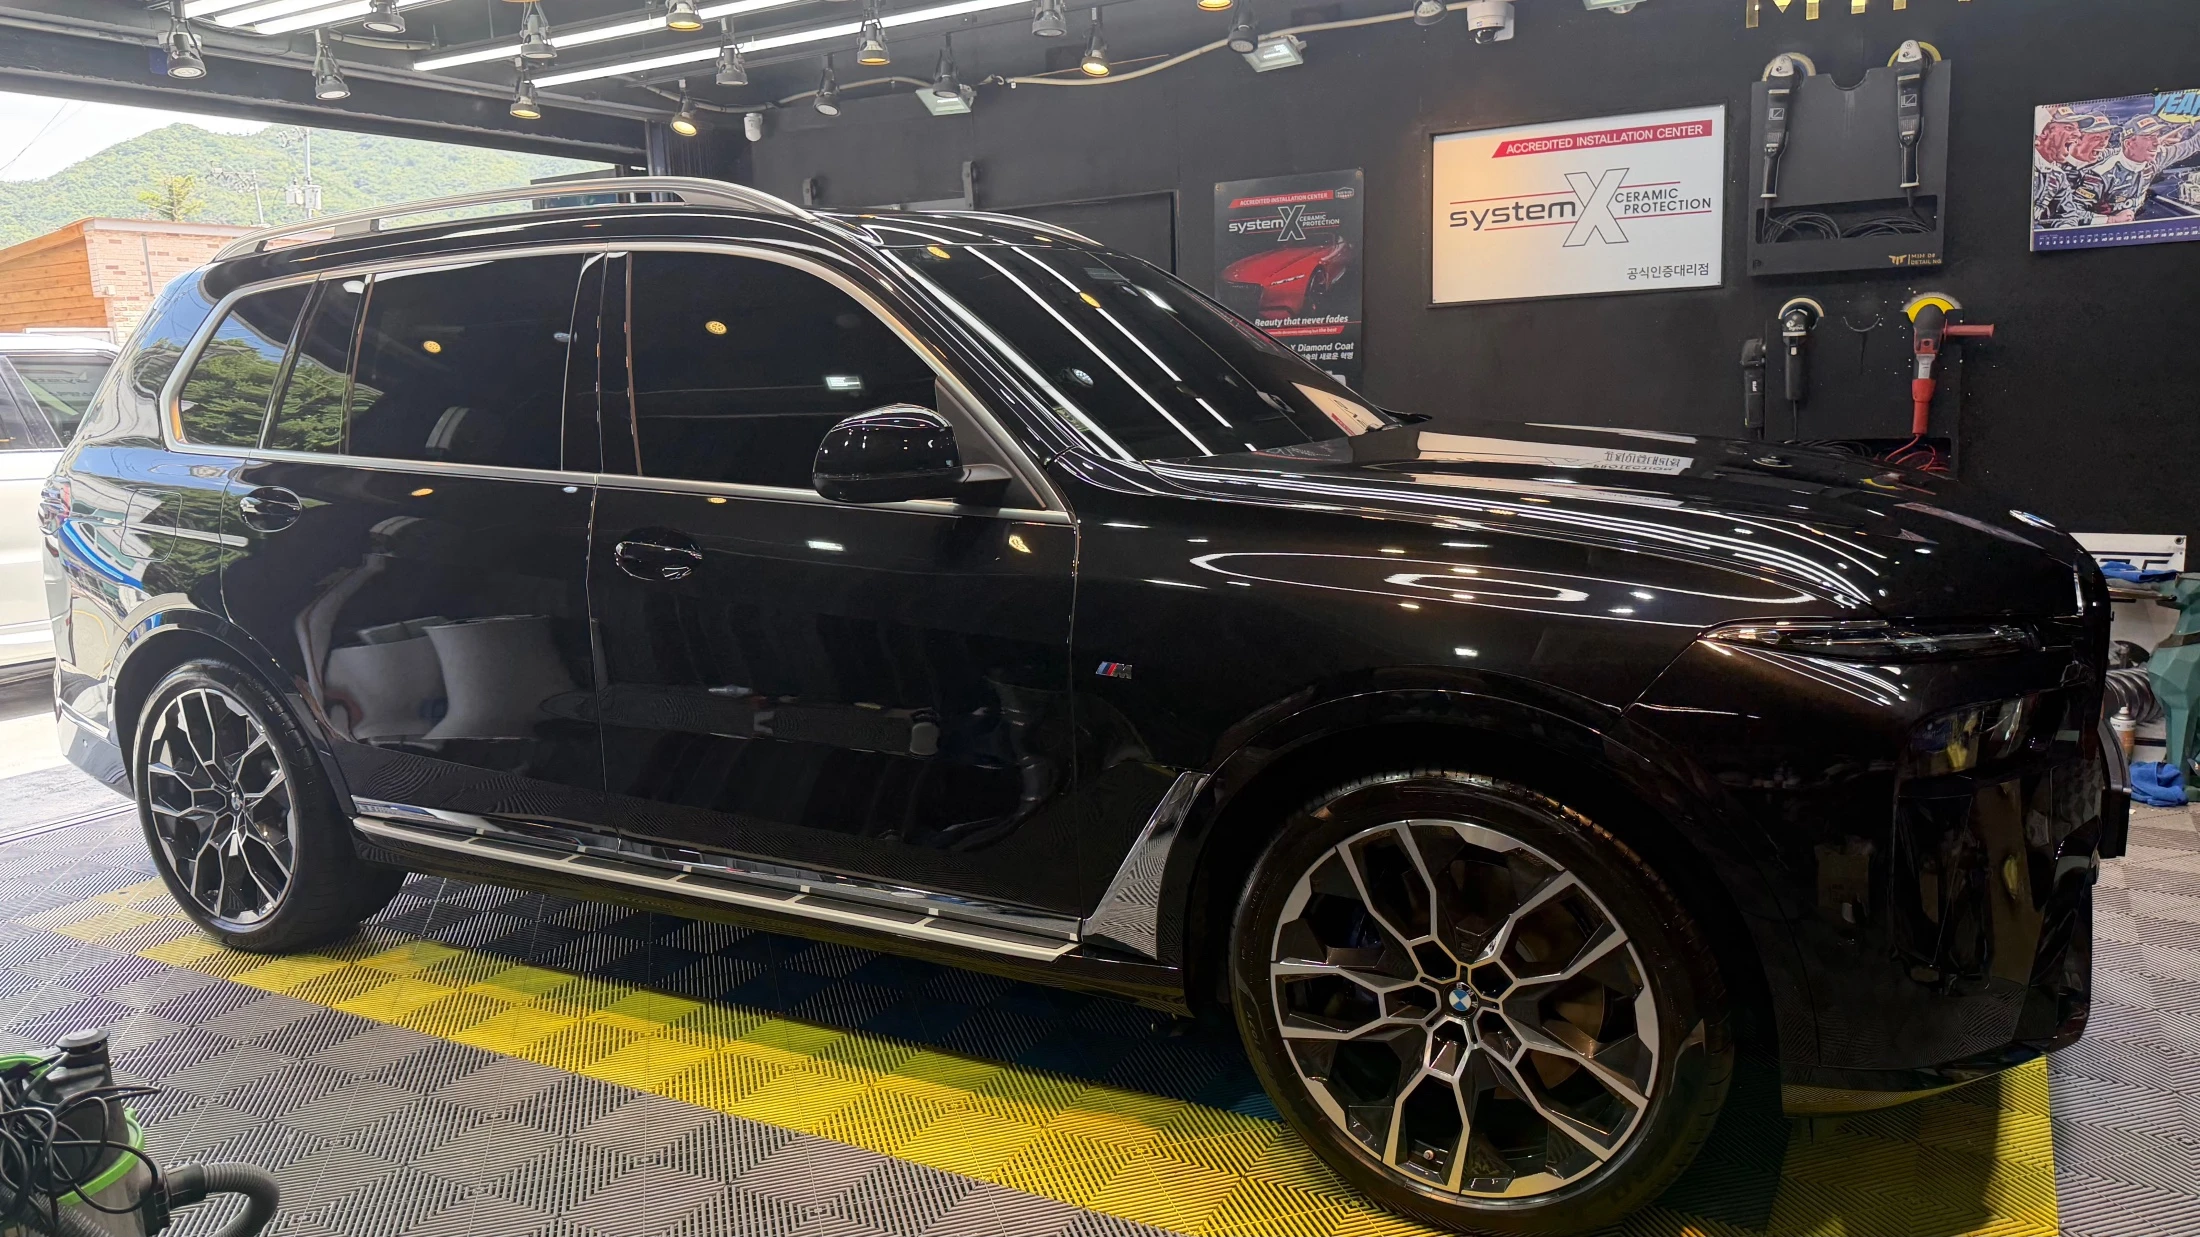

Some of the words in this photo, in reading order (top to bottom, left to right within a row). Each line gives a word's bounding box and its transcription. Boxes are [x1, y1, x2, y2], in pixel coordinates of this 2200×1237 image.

[1505, 138, 1573, 154] ACCREDITED
[1576, 129, 1653, 146] INSTALLATION
[1656, 124, 1703, 138] CENTER
[1240, 198, 1271, 206] ACCREDITED
[1271, 194, 1306, 203] INSTALLATION
[1307, 192, 1328, 200] CENTER
[1615, 188, 1679, 203] CERAMIC
[1450, 201, 1576, 231] system
[1562, 167, 1630, 247] X
[1624, 197, 1711, 214] PROTECTION
[1300, 214, 1326, 222] CERAMIC
[1302, 219, 1340, 227] PROTECTION
[1229, 219, 1284, 233] system
[1627, 262, 1709, 280] 공식인증대리점
[1255, 318, 1282, 328] Beauty
[1284, 316, 1301, 326] that
[1302, 316, 1325, 325] never
[1325, 314, 1349, 325] fades
[1297, 342, 1333, 352] Diamond
[1335, 341, 1354, 351] Coat
